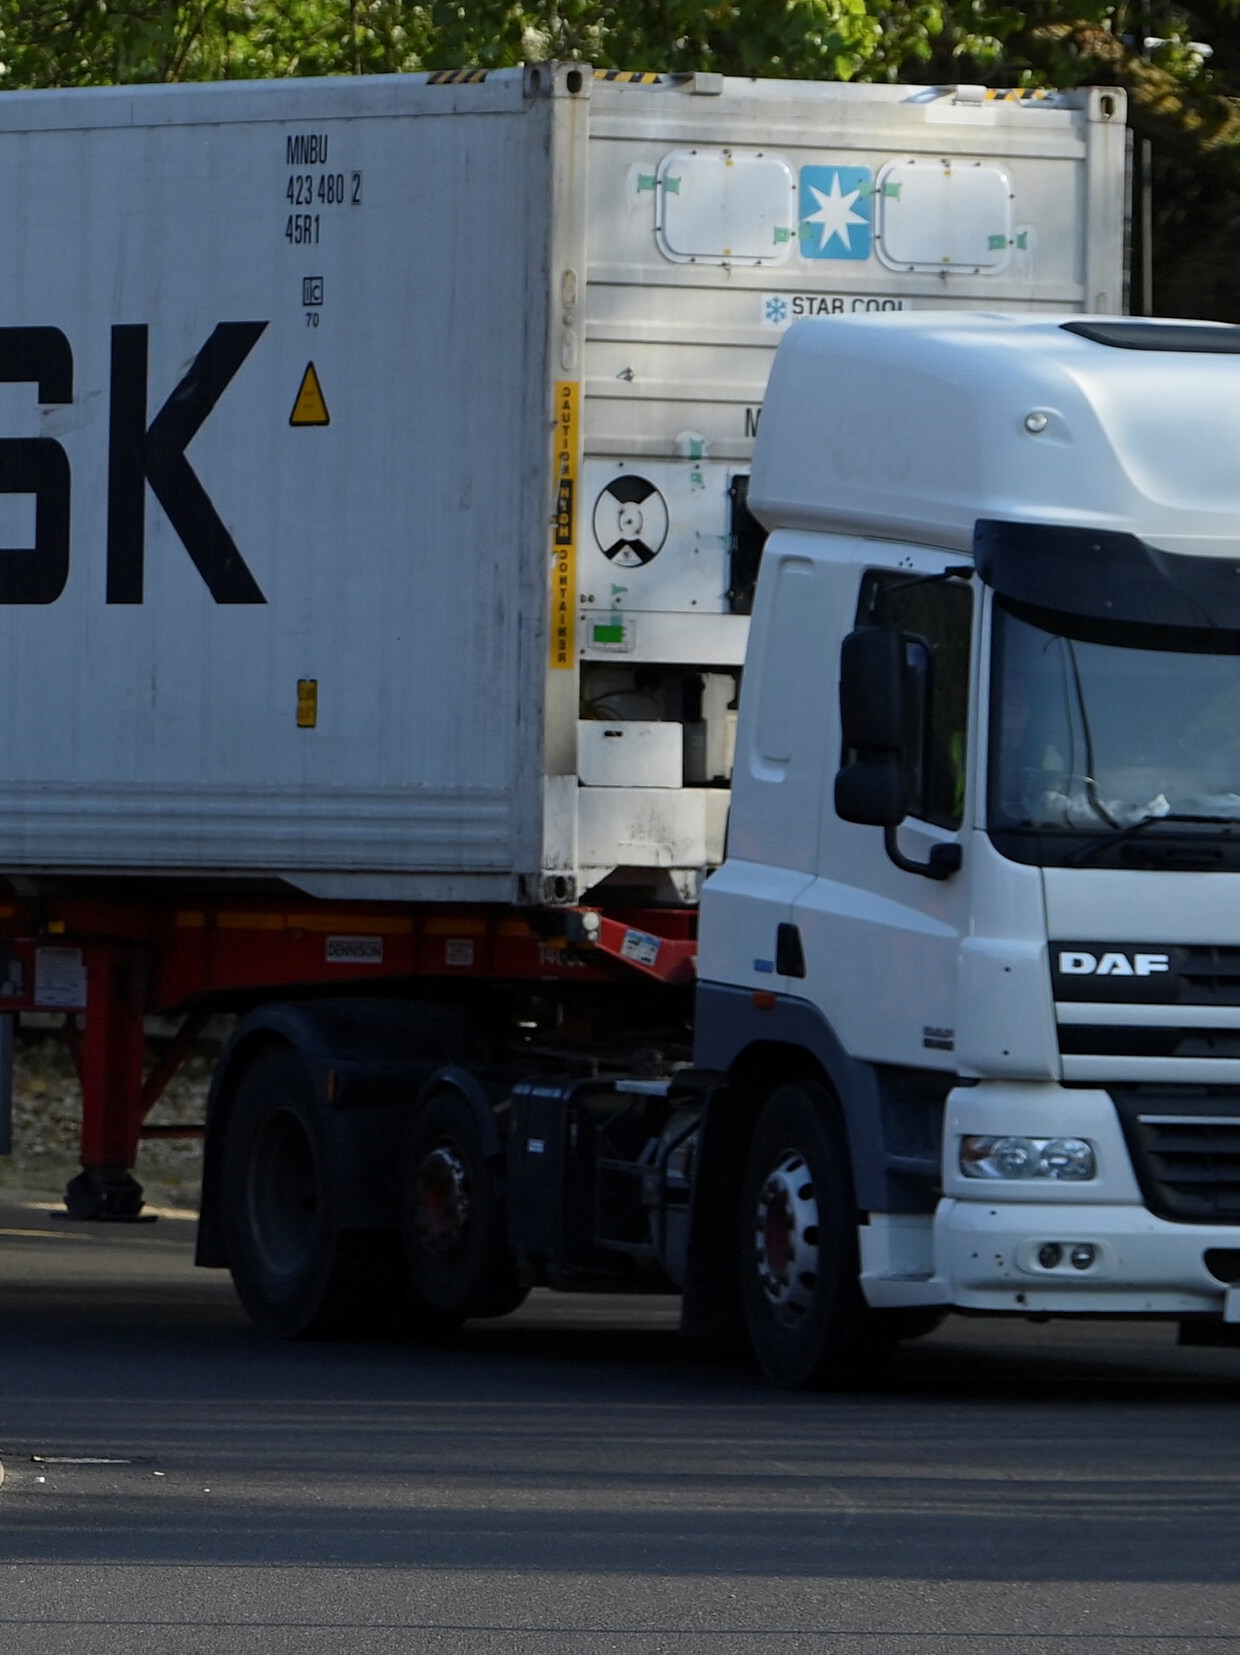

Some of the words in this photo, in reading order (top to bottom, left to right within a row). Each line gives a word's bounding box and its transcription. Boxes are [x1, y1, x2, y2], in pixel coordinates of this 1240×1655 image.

[286, 134, 328, 166] MNBU
[286, 173, 313, 206] 423
[317, 172, 345, 205] 480
[352, 171, 362, 205] 2
[285, 214, 321, 245] 45R1
[792, 296, 845, 315] STAR
[305, 312, 320, 328] 70
[1058, 951, 1170, 976] DAF
